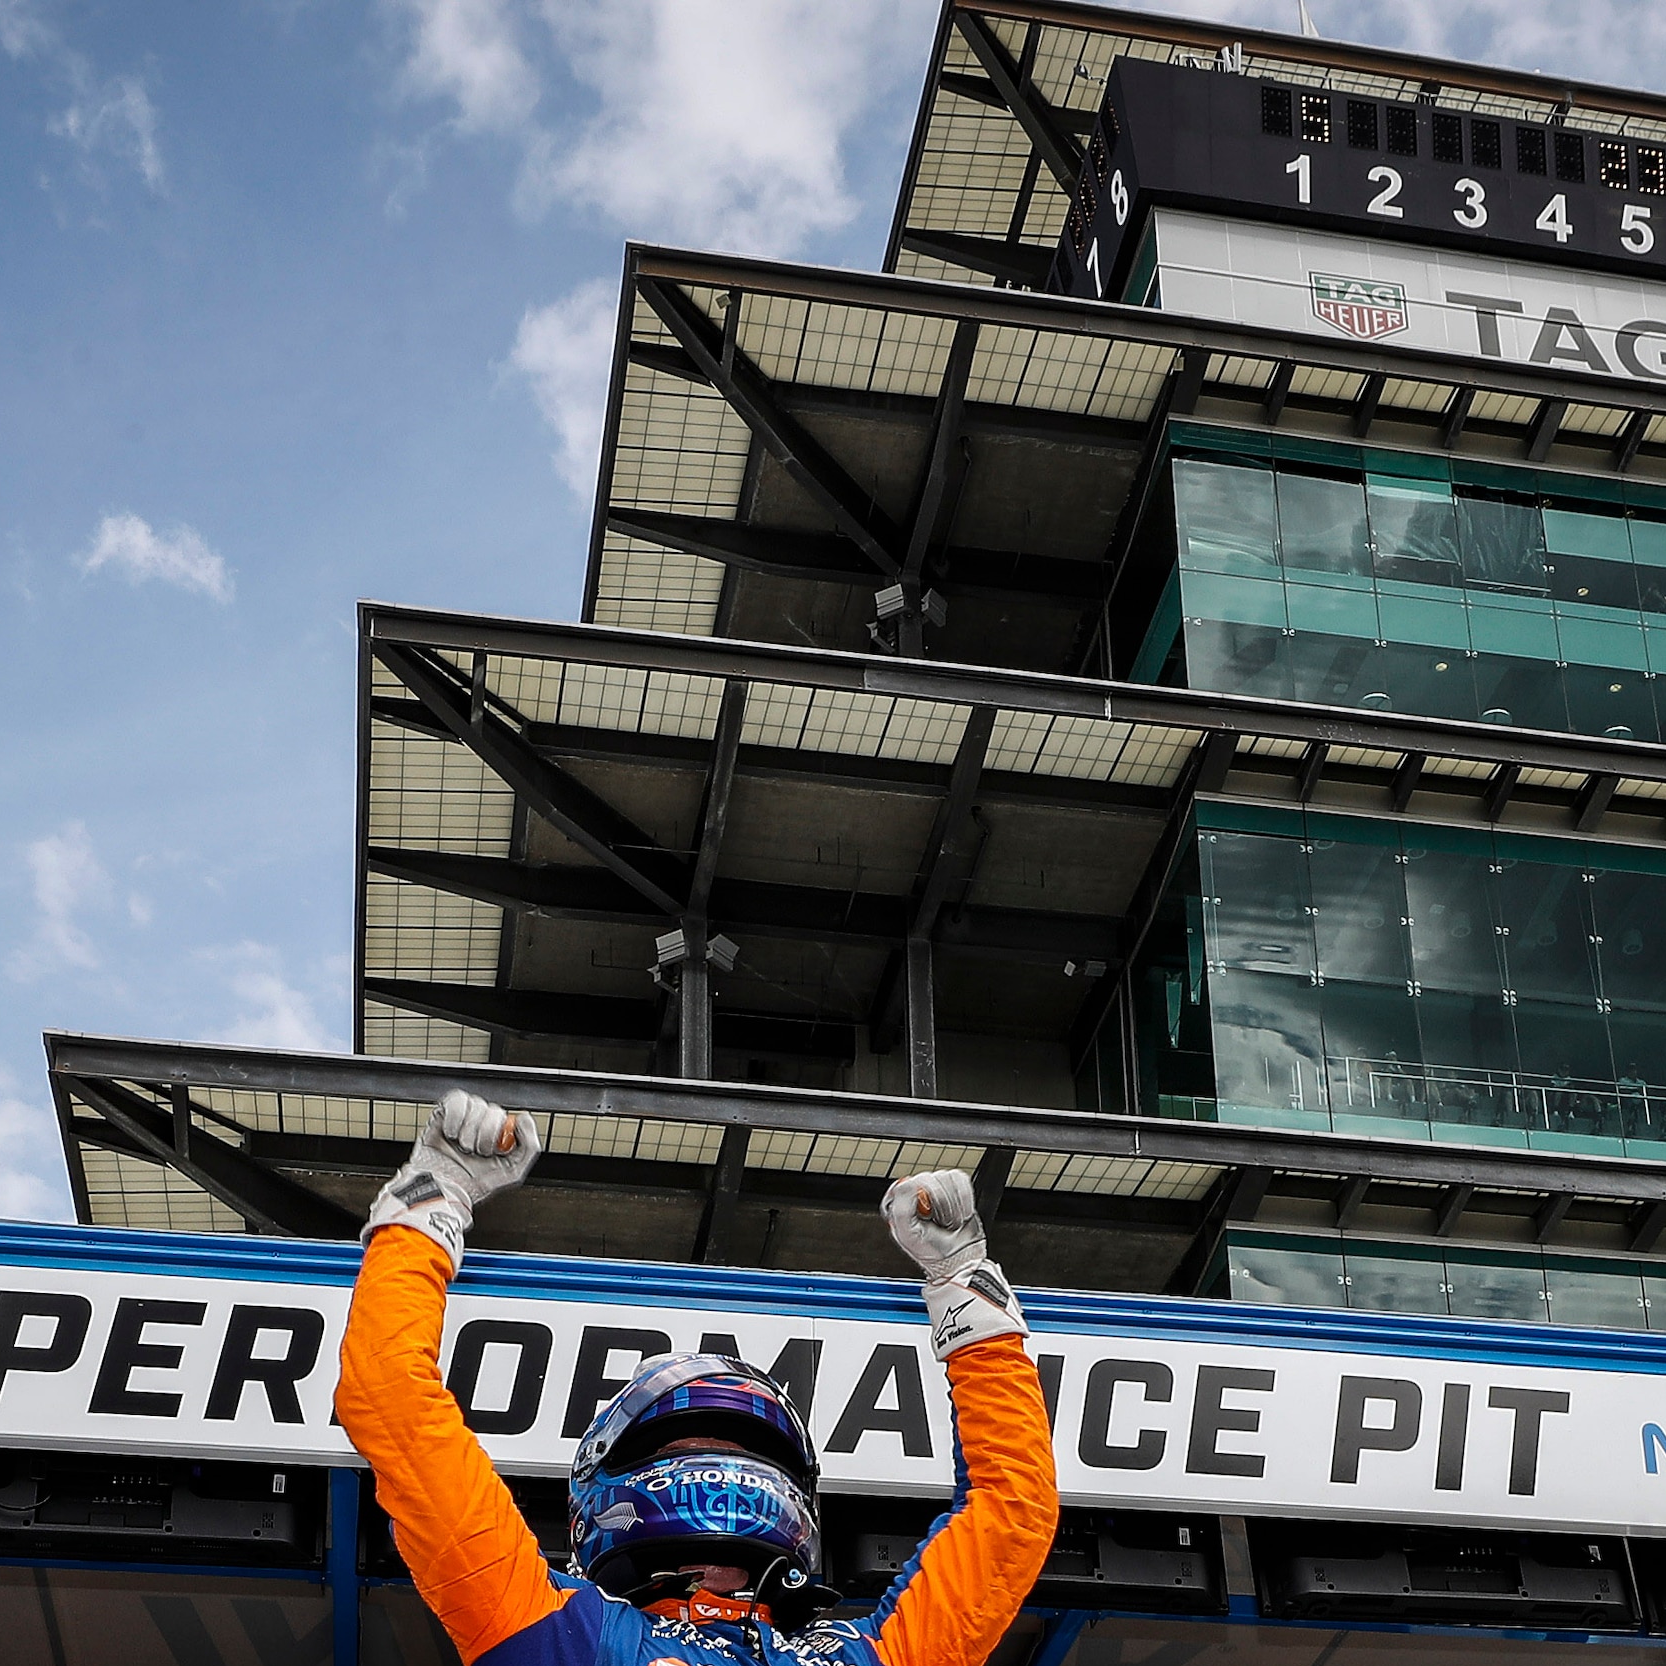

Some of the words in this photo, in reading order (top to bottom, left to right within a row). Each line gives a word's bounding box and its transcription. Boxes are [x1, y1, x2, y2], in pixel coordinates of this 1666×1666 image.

[1301, 95, 1330, 144] 5
[1598, 141, 1666, 196] 23
[1111, 168, 1130, 226] 8
[1285, 154, 1312, 204] 1
[1366, 166, 1404, 219] 2
[1452, 177, 1488, 229] 3
[1535, 193, 1574, 244] 4
[1620, 203, 1655, 254] 5
[1318, 301, 1402, 338] HEUER
[1319, 277, 1397, 305] TAG
[1329, 1373, 1571, 1496] PIT
[680, 1469, 777, 1496] HONDA
